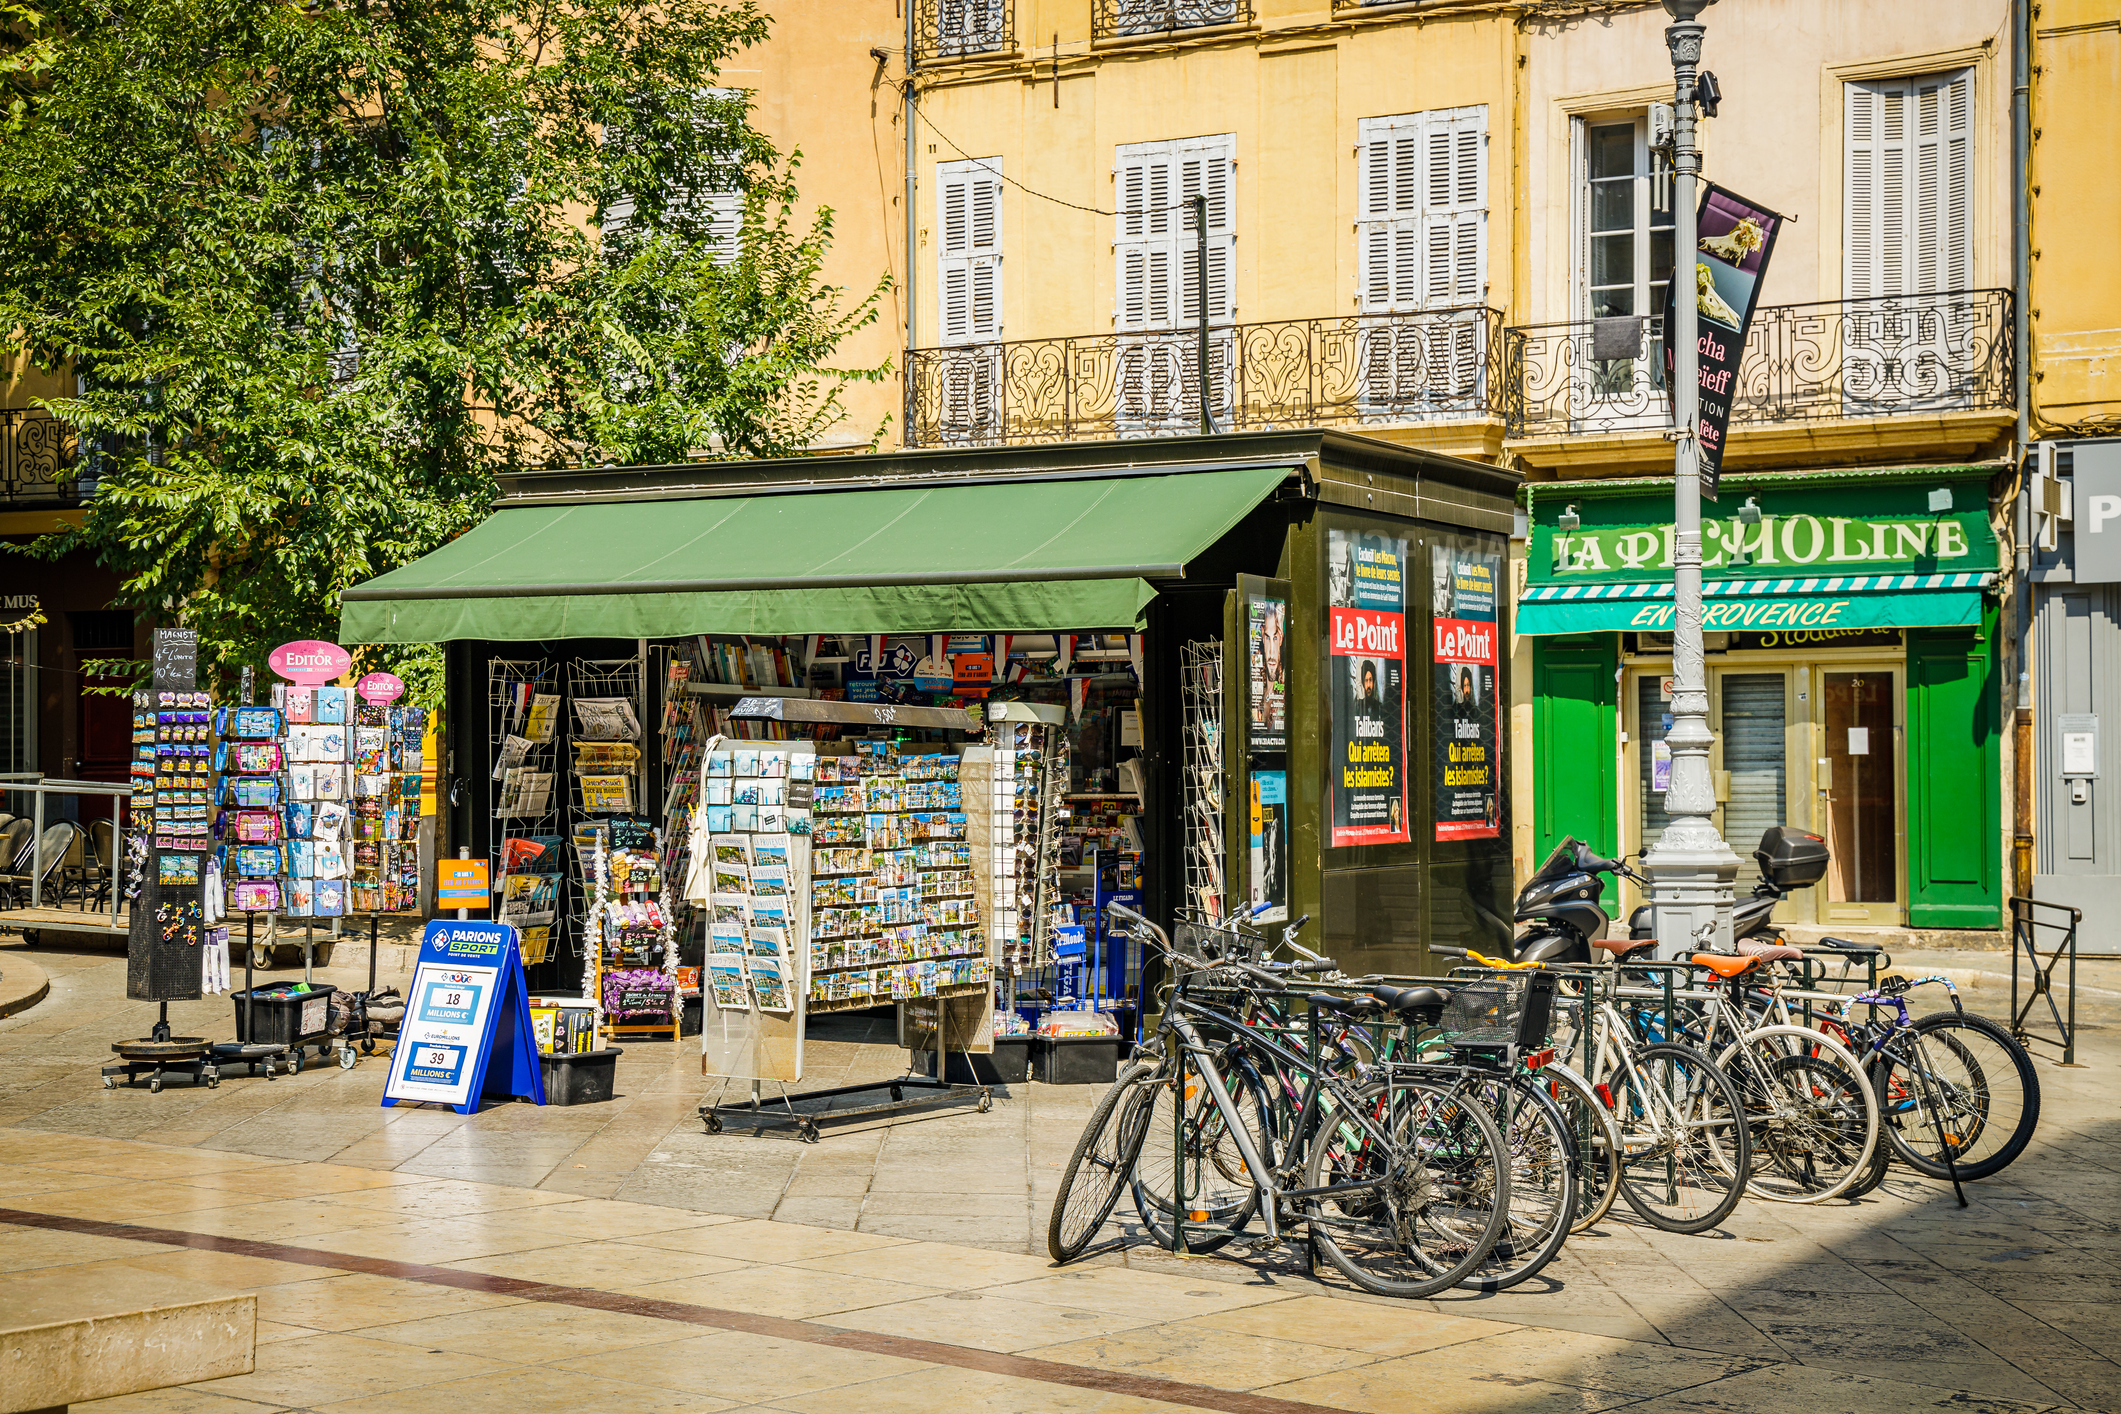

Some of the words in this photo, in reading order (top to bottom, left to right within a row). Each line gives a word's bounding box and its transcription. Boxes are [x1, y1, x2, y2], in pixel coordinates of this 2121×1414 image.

[1631, 605, 1675, 626] EN
[1701, 601, 1850, 626] ROVENCE
[1336, 615, 1355, 649] Le
[1356, 615, 1398, 652] Point
[1436, 625, 1456, 656] Le
[1457, 625, 1490, 659] Point
[860, 653, 888, 668] FJ
[1851, 679, 1865, 688] 20
[1354, 715, 1385, 738] Talibans
[1453, 719, 1480, 739] Talibans
[1348, 740, 1362, 763] Qui
[1362, 741, 1390, 762] arrêtera
[1448, 742, 1461, 762] Qui
[1461, 742, 1485, 762] arrêtera
[1343, 766, 1355, 788] les
[1444, 766, 1455, 786] les
[452, 930, 502, 943] PARIONS
[451, 943, 497, 953] SPORT
[446, 993, 461, 1006] 18
[427, 1009, 461, 1019] MILLIONS
[430, 1052, 445, 1065] 39
[411, 1069, 444, 1078] MILLIONS
